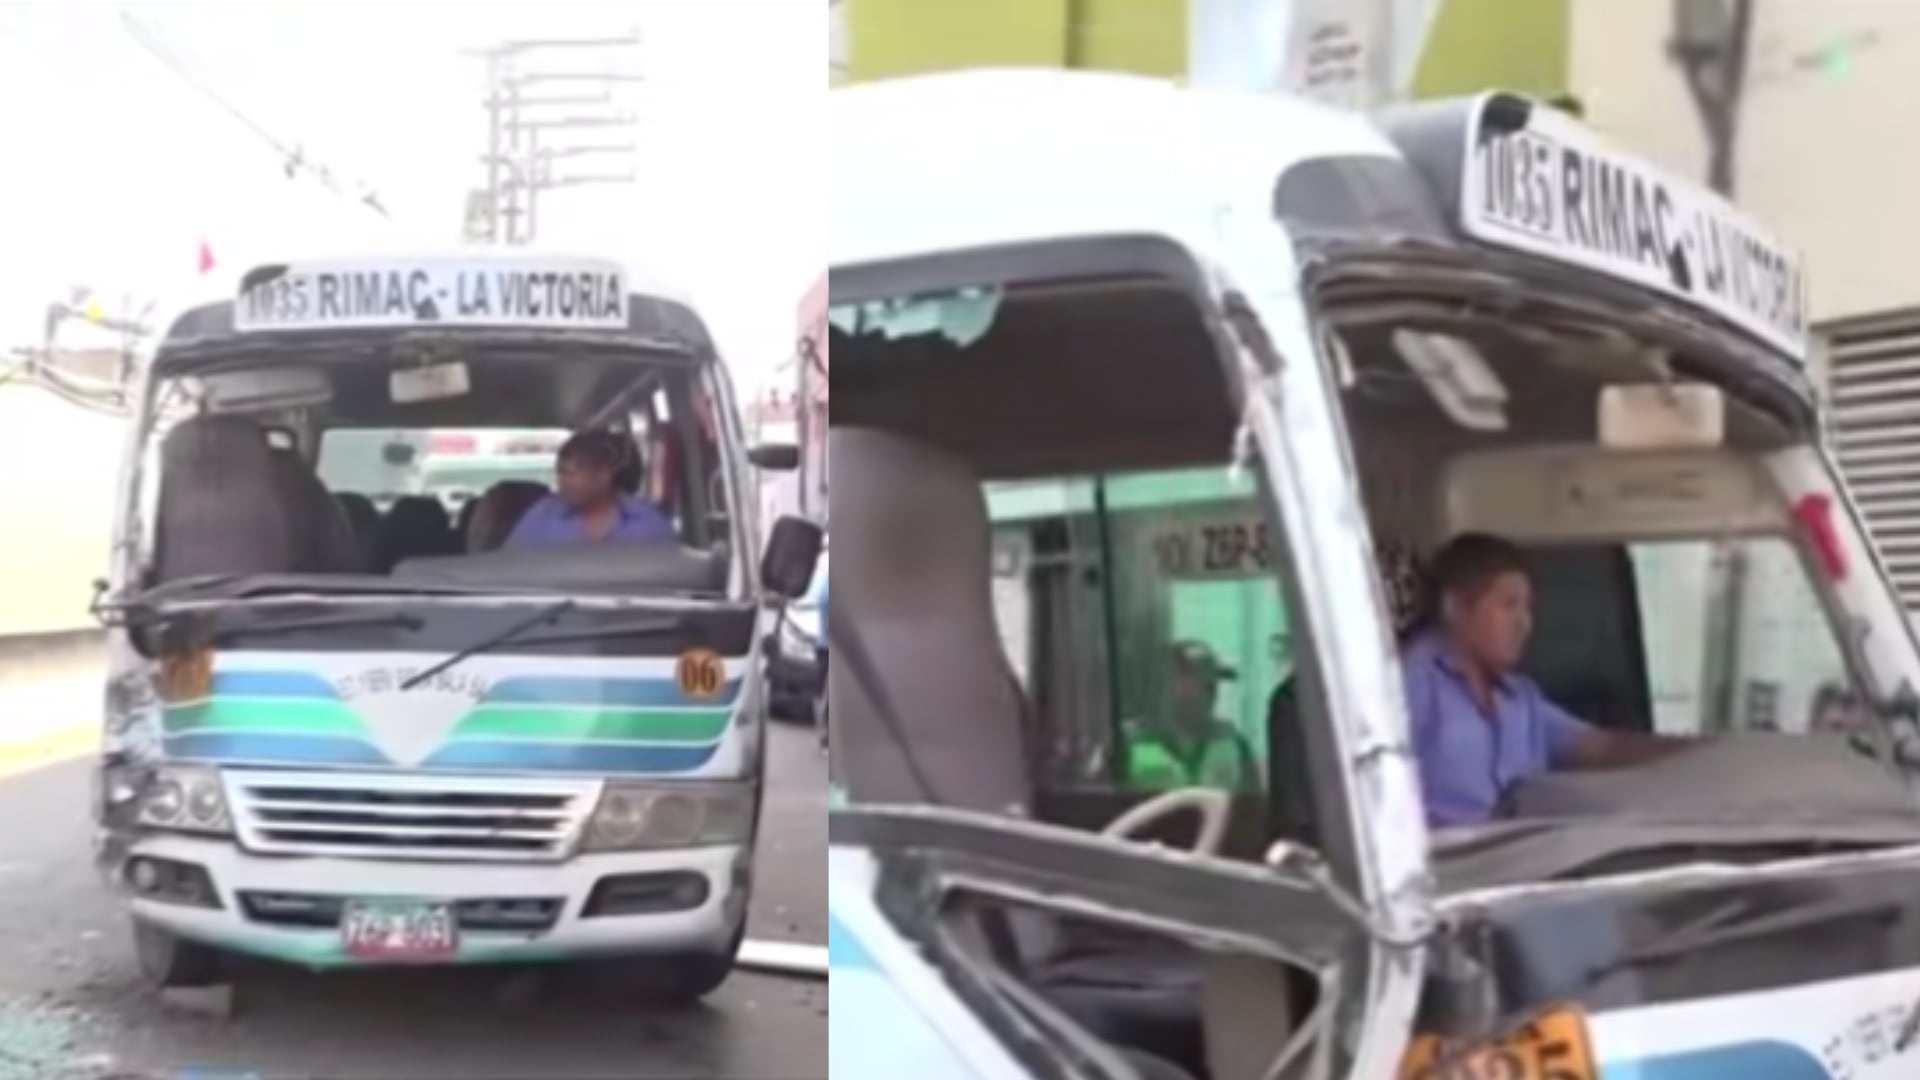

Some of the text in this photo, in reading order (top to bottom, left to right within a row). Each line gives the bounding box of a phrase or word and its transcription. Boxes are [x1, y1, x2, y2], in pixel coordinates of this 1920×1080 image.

[1482, 135, 1552, 233] 1035
[1562, 146, 1676, 270] RIMAC
[1695, 206, 1728, 296] LA
[248, 275, 309, 321] 1035
[317, 270, 430, 319] RIMAC
[456, 271, 490, 317] LA
[498, 271, 623, 319] VICTORIA
[681, 656, 717, 694] 06
